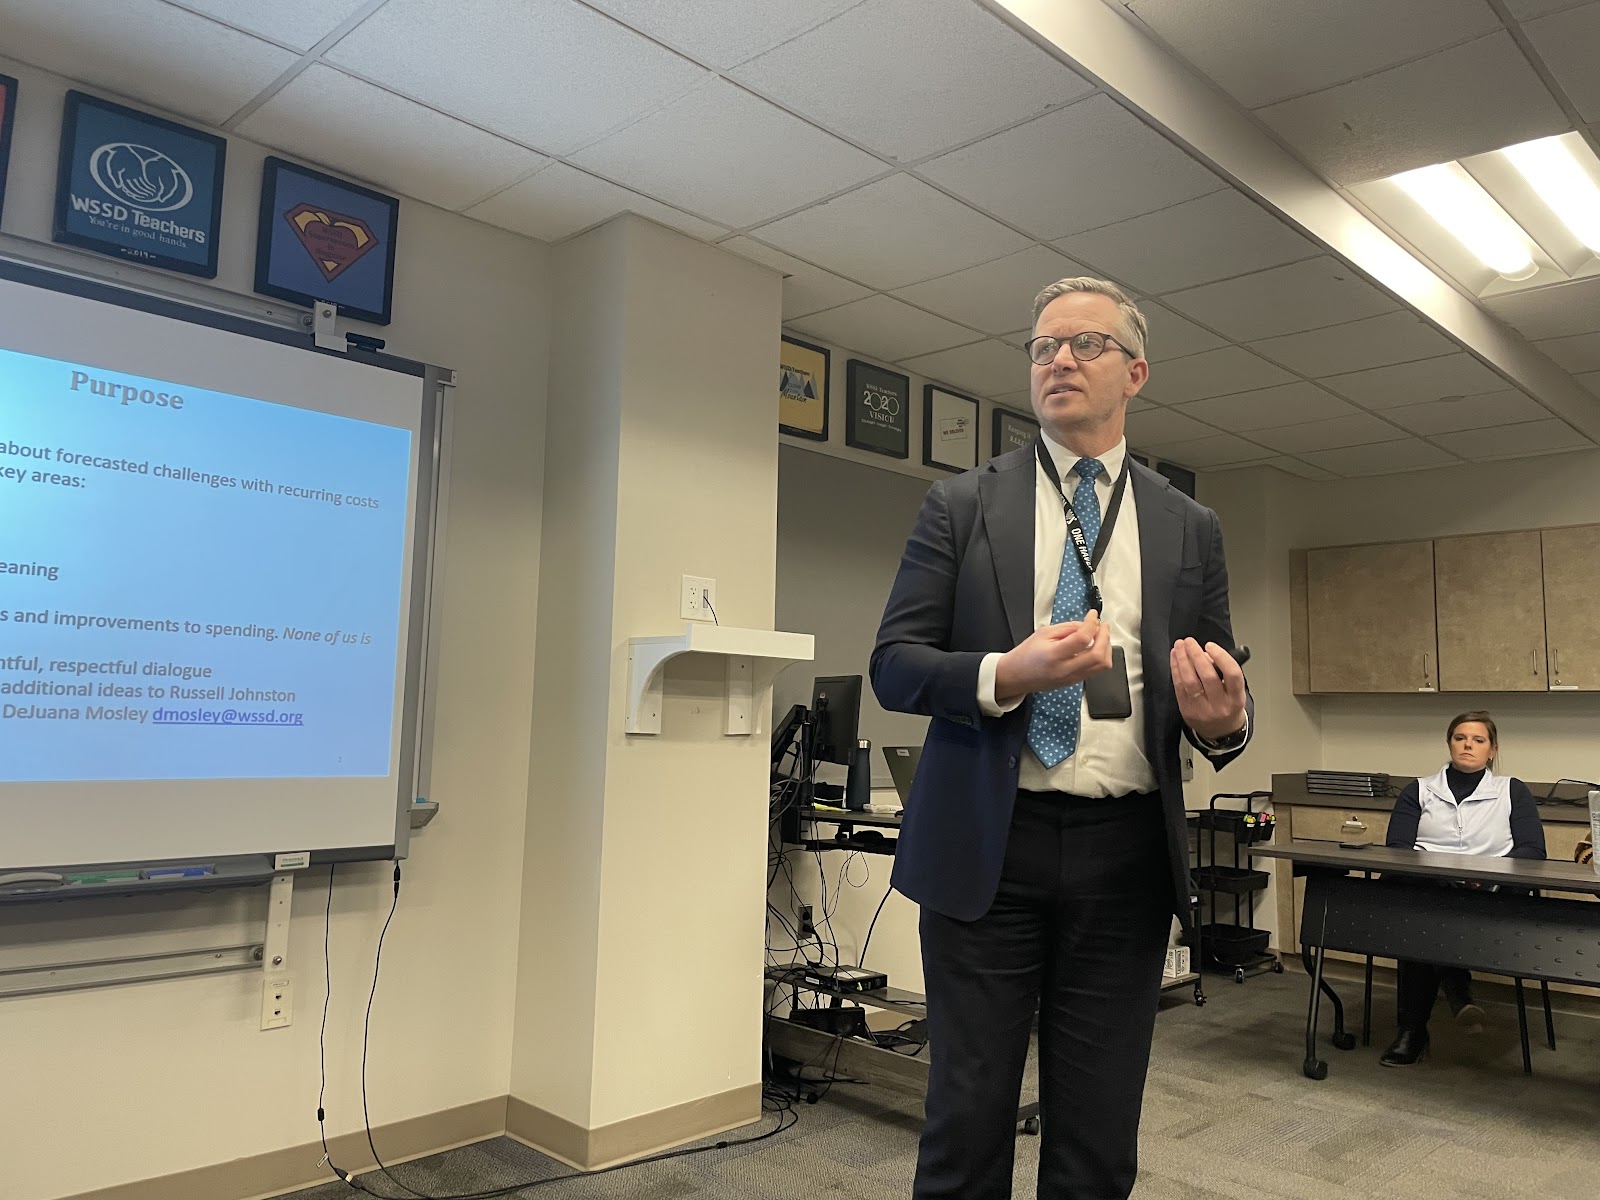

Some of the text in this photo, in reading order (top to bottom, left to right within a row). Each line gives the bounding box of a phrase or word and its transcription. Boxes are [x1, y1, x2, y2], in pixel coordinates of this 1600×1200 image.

[71, 193, 206, 243] WSSD Teachers
[88, 215, 119, 230] You're
[121, 224, 130, 233] in
[132, 228, 156, 240] good
[70, 370, 184, 410] Purpose
[863, 390, 900, 416] 2020
[869, 410, 895, 424] VISION
[0, 440, 379, 509] about forecasted challenges with recurring costs
[31, 471, 86, 489] areas:
[1071, 527, 1086, 546] ONE
[14, 610, 49, 624] and
[54, 611, 179, 633] improvements
[184, 620, 201, 634] to
[205, 624, 278, 642] spending.
[283, 627, 321, 642] None
[324, 630, 341, 646] of
[342, 633, 357, 644] us
[360, 632, 371, 645] is
[50, 660, 138, 676] respectful
[142, 661, 212, 680] dialogue
[1, 680, 296, 702] additional ideas to Russell Johnston
[3, 704, 304, 726] DeJuana Mosley dmosley@wssd.org
